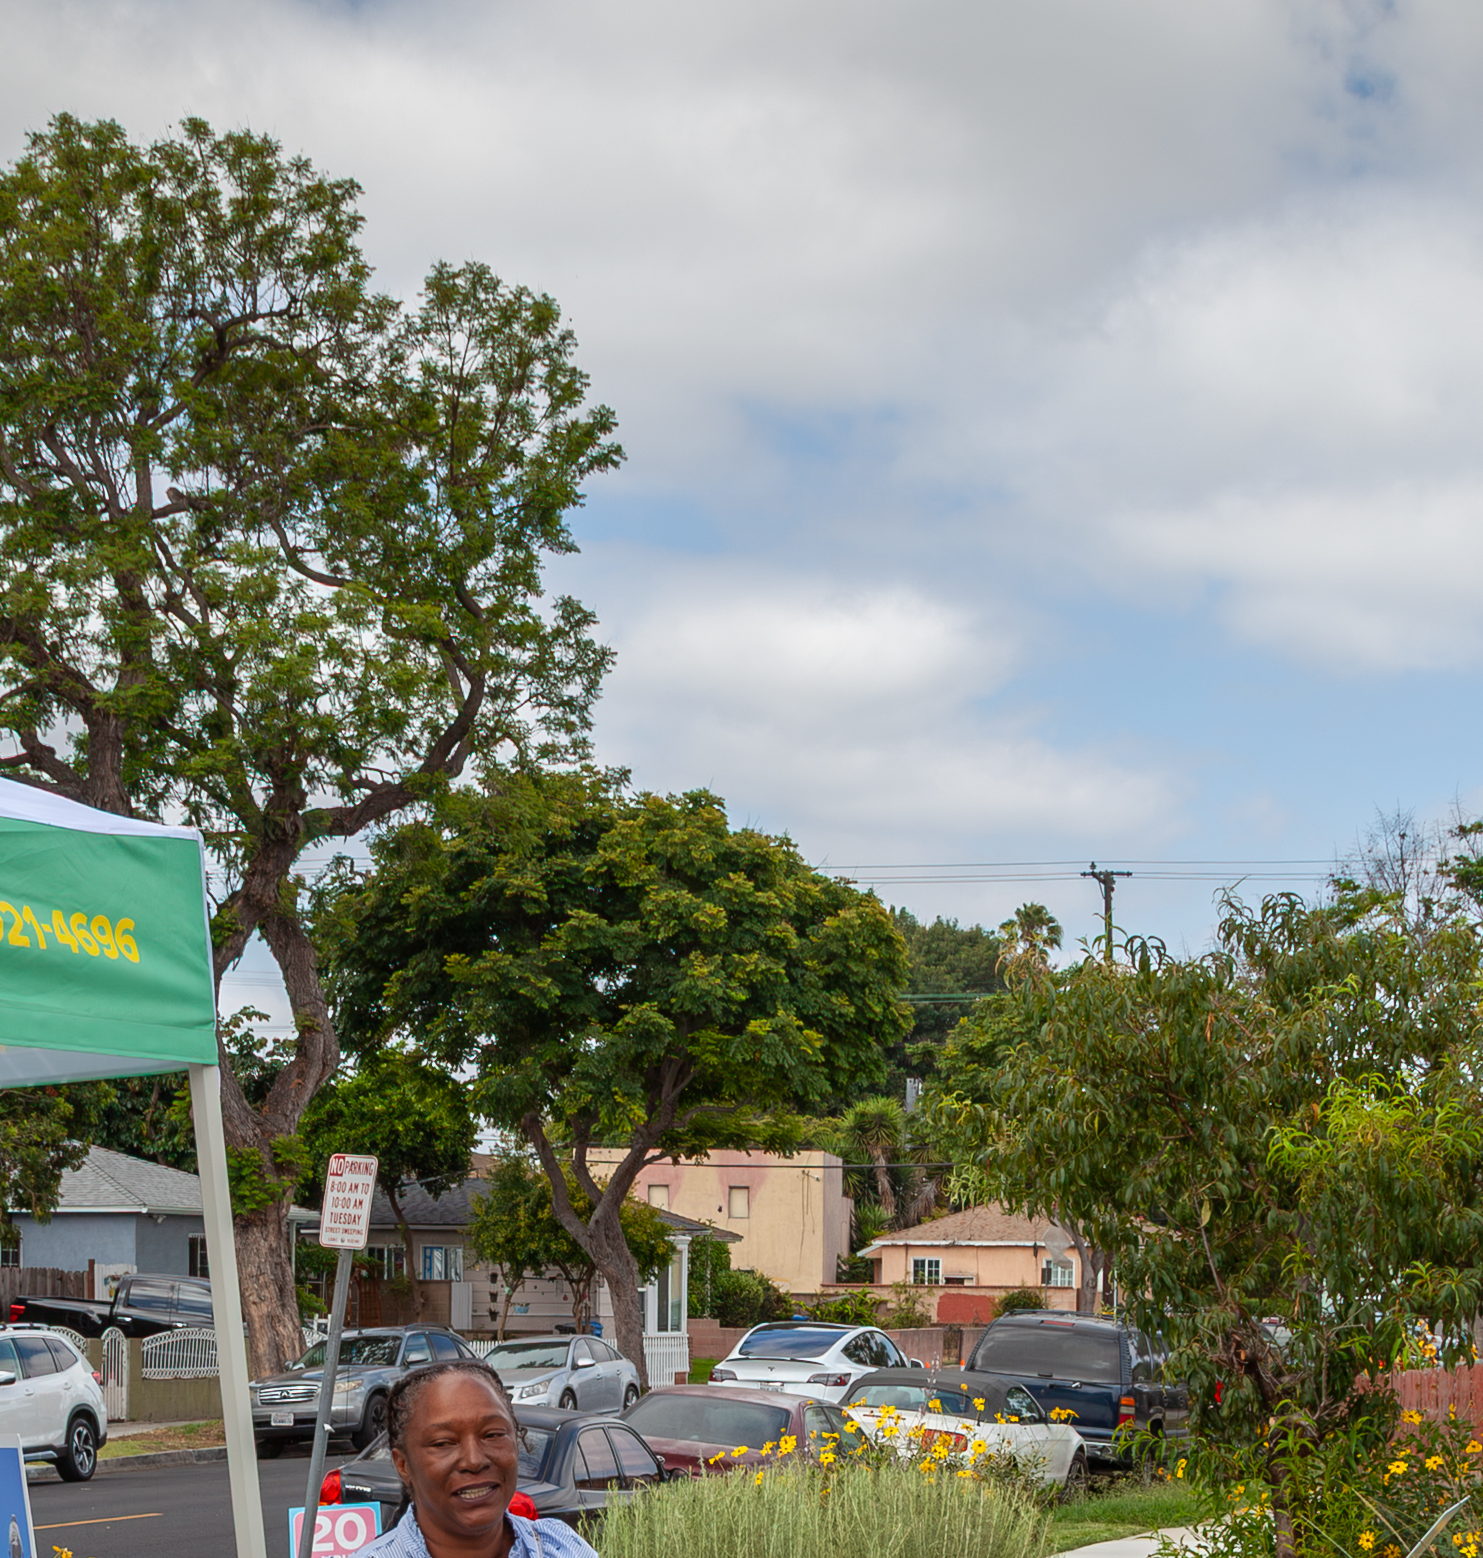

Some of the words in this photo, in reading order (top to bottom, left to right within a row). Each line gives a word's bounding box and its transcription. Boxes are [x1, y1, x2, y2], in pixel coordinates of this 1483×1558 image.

[330, 1157, 345, 1175] NO
[345, 1160, 374, 1176] PARKING
[330, 1180, 347, 1193] 8:00
[348, 1182, 359, 1194] AM
[361, 1182, 370, 1195] TO
[331, 1196, 352, 1209] 10:00
[352, 1198, 364, 1210] AM
[329, 1211, 363, 1226] TUESDAY
[325, 1226, 341, 1234] STREET
[341, 1228, 364, 1236] SWEEPING
